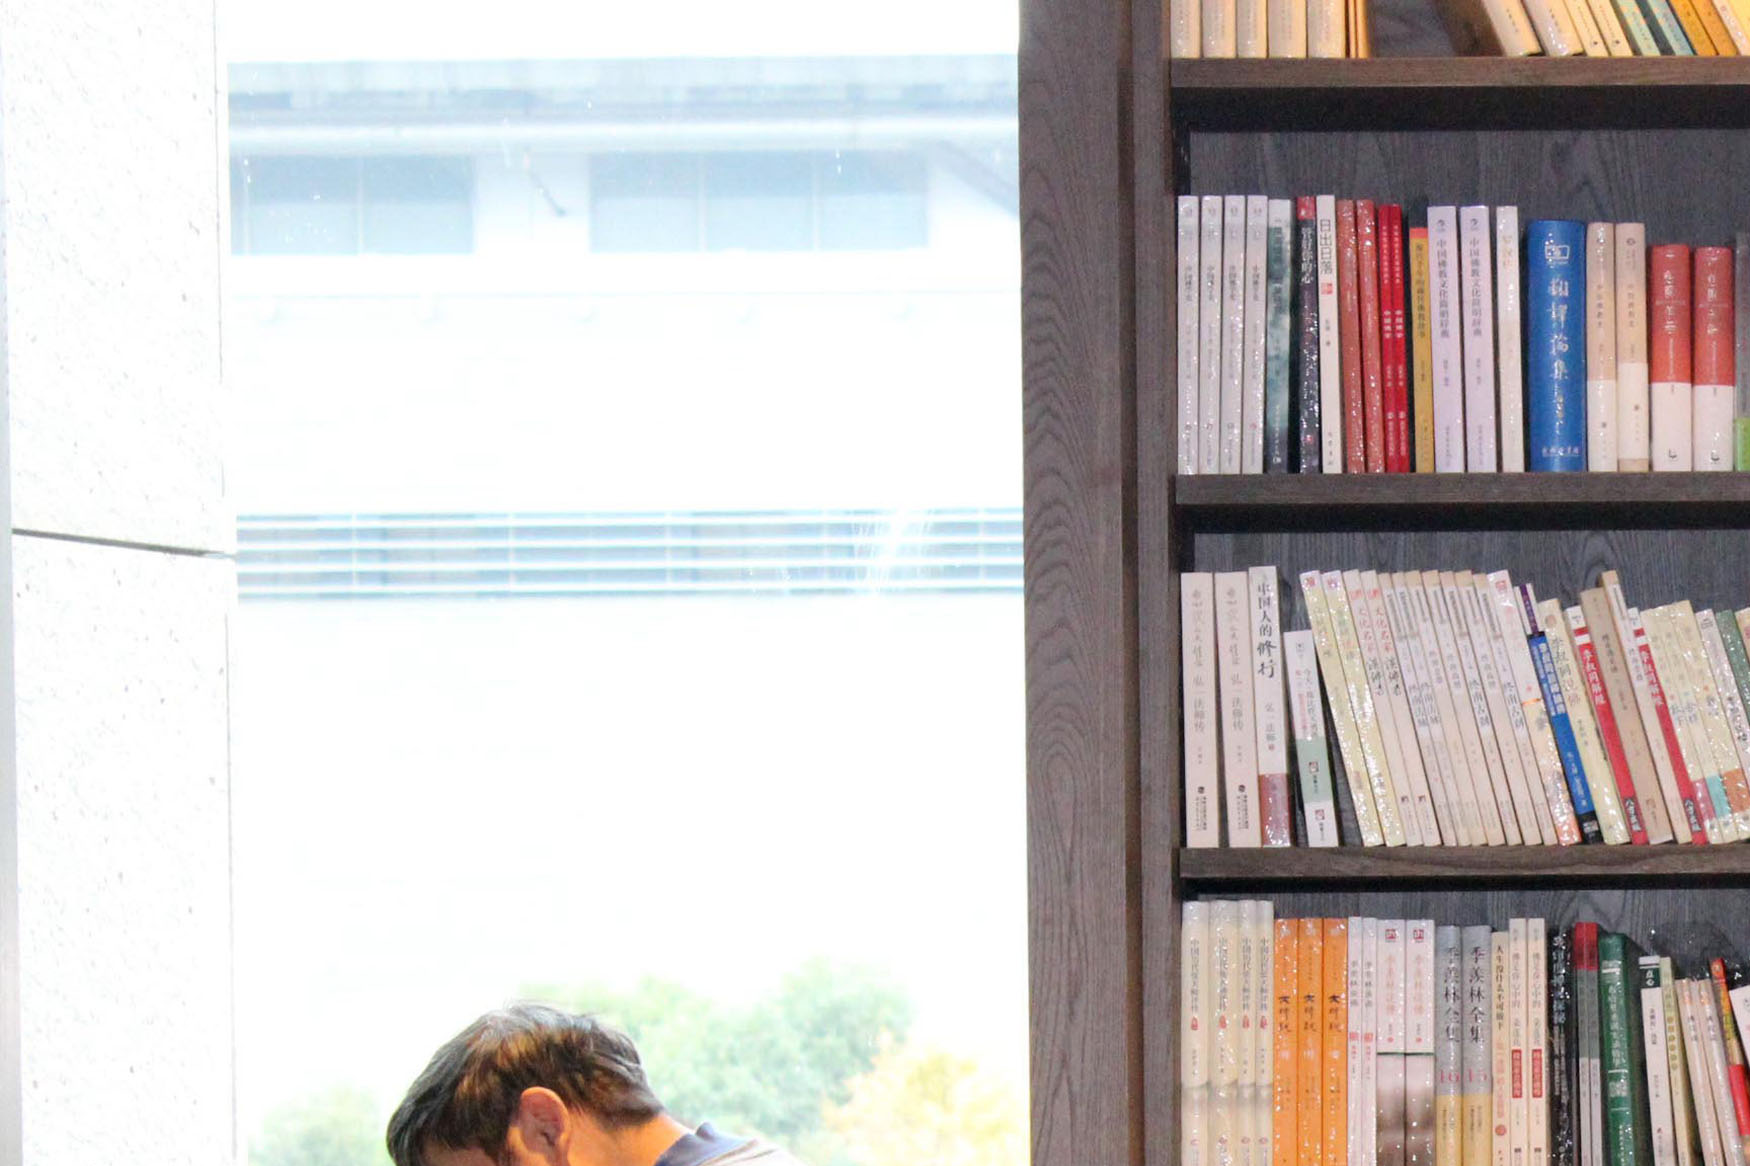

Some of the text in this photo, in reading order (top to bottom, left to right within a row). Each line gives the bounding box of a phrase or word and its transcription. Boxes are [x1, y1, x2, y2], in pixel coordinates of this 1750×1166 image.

[1256, 582, 1277, 680] 中国人的修行
[1469, 946, 1486, 1044] 季羡林全集
